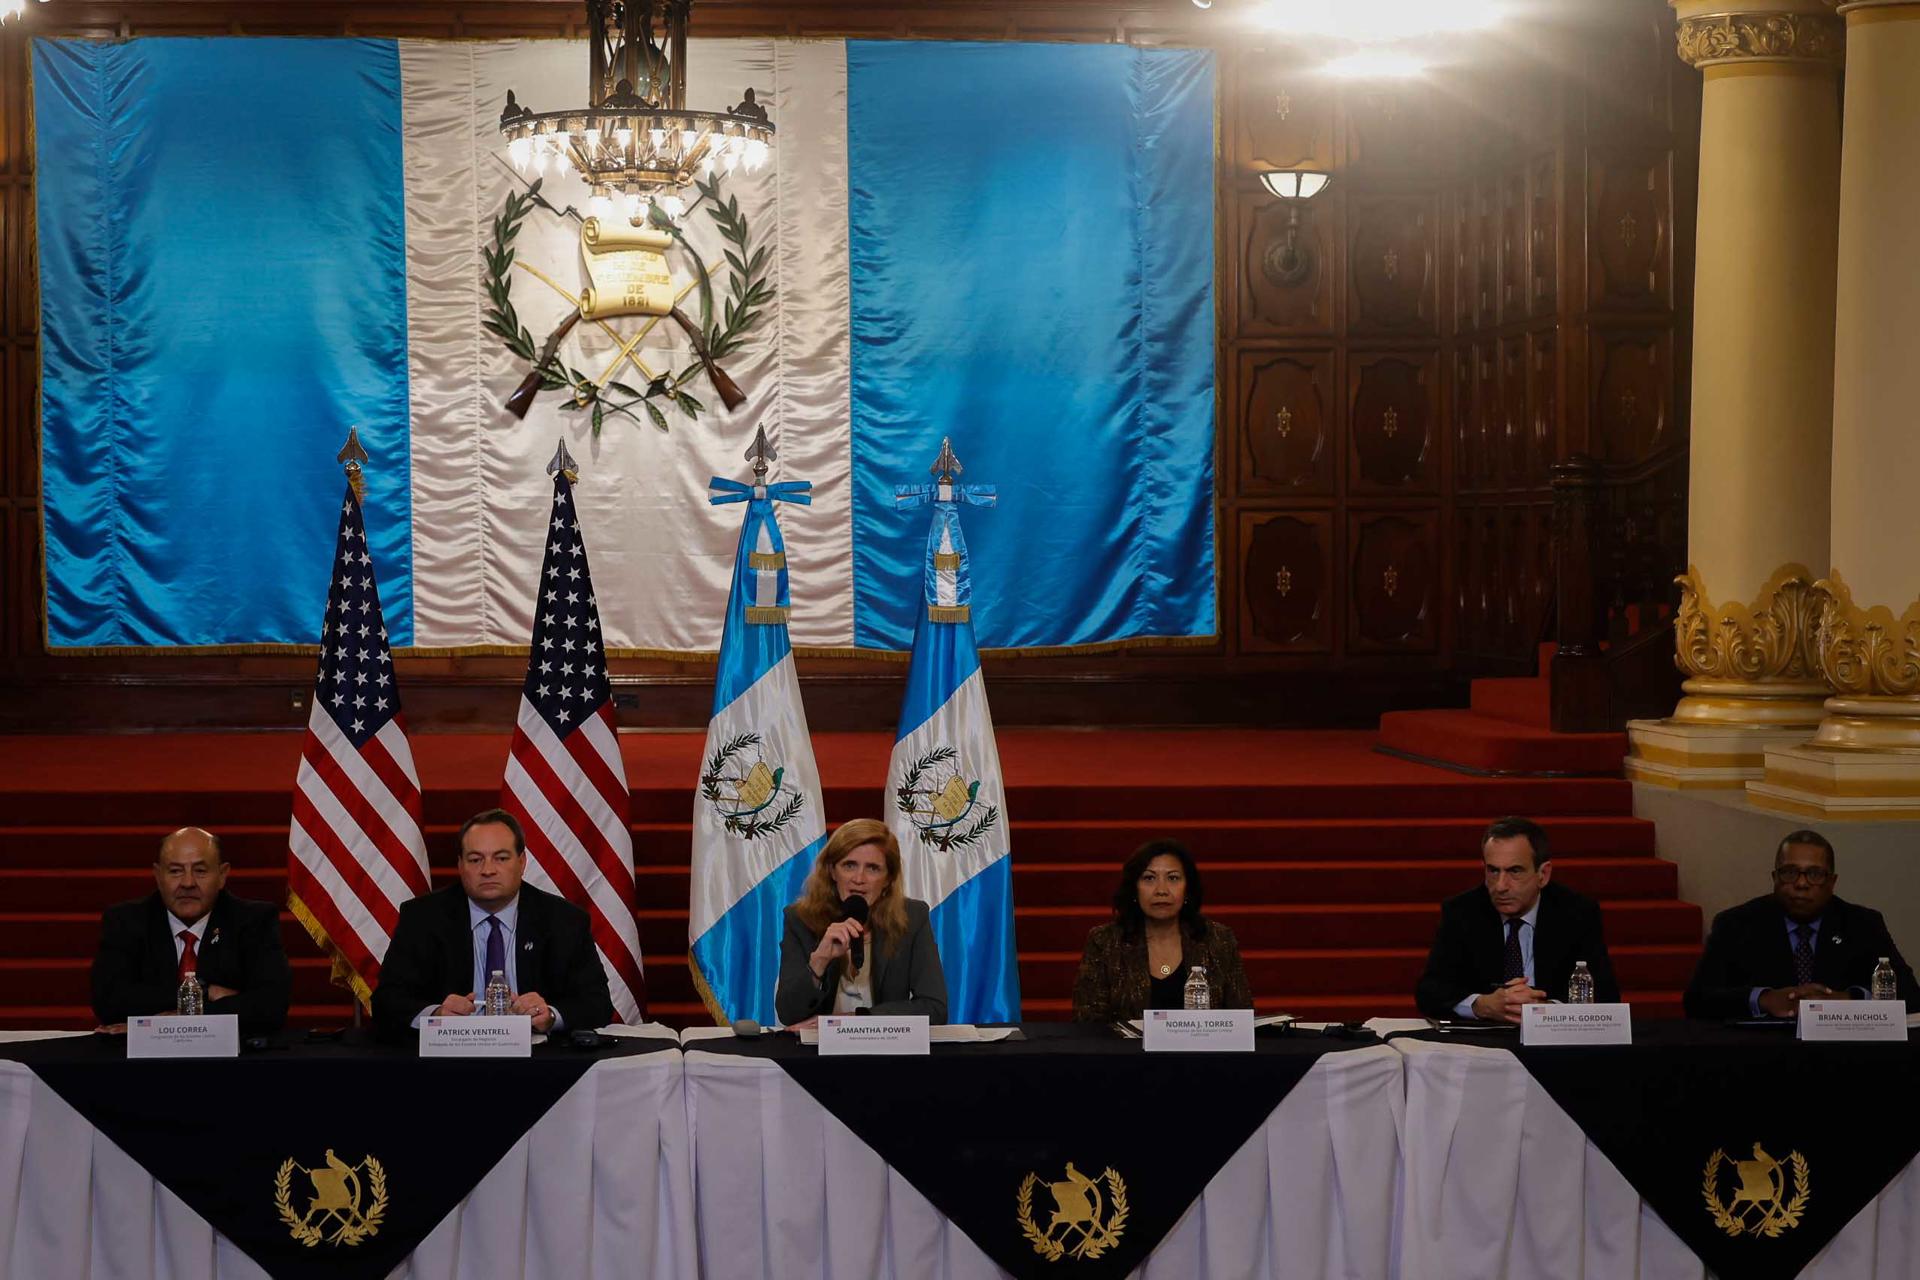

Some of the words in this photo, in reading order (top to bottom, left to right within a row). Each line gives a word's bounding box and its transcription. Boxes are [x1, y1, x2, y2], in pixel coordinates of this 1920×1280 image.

[627, 284, 644, 295] DE
[1578, 1014, 1613, 1022] GORDON
[1853, 1013, 1888, 1021] NICHOLS
[1165, 1020, 1196, 1028] NORMA
[1197, 1020, 1203, 1029] J.
[1204, 1020, 1234, 1028] TORRES
[158, 1026, 175, 1034] LOU
[176, 1026, 208, 1034] CORREA
[471, 1028, 511, 1036] VENTRELL
[883, 1026, 911, 1034] POWER
